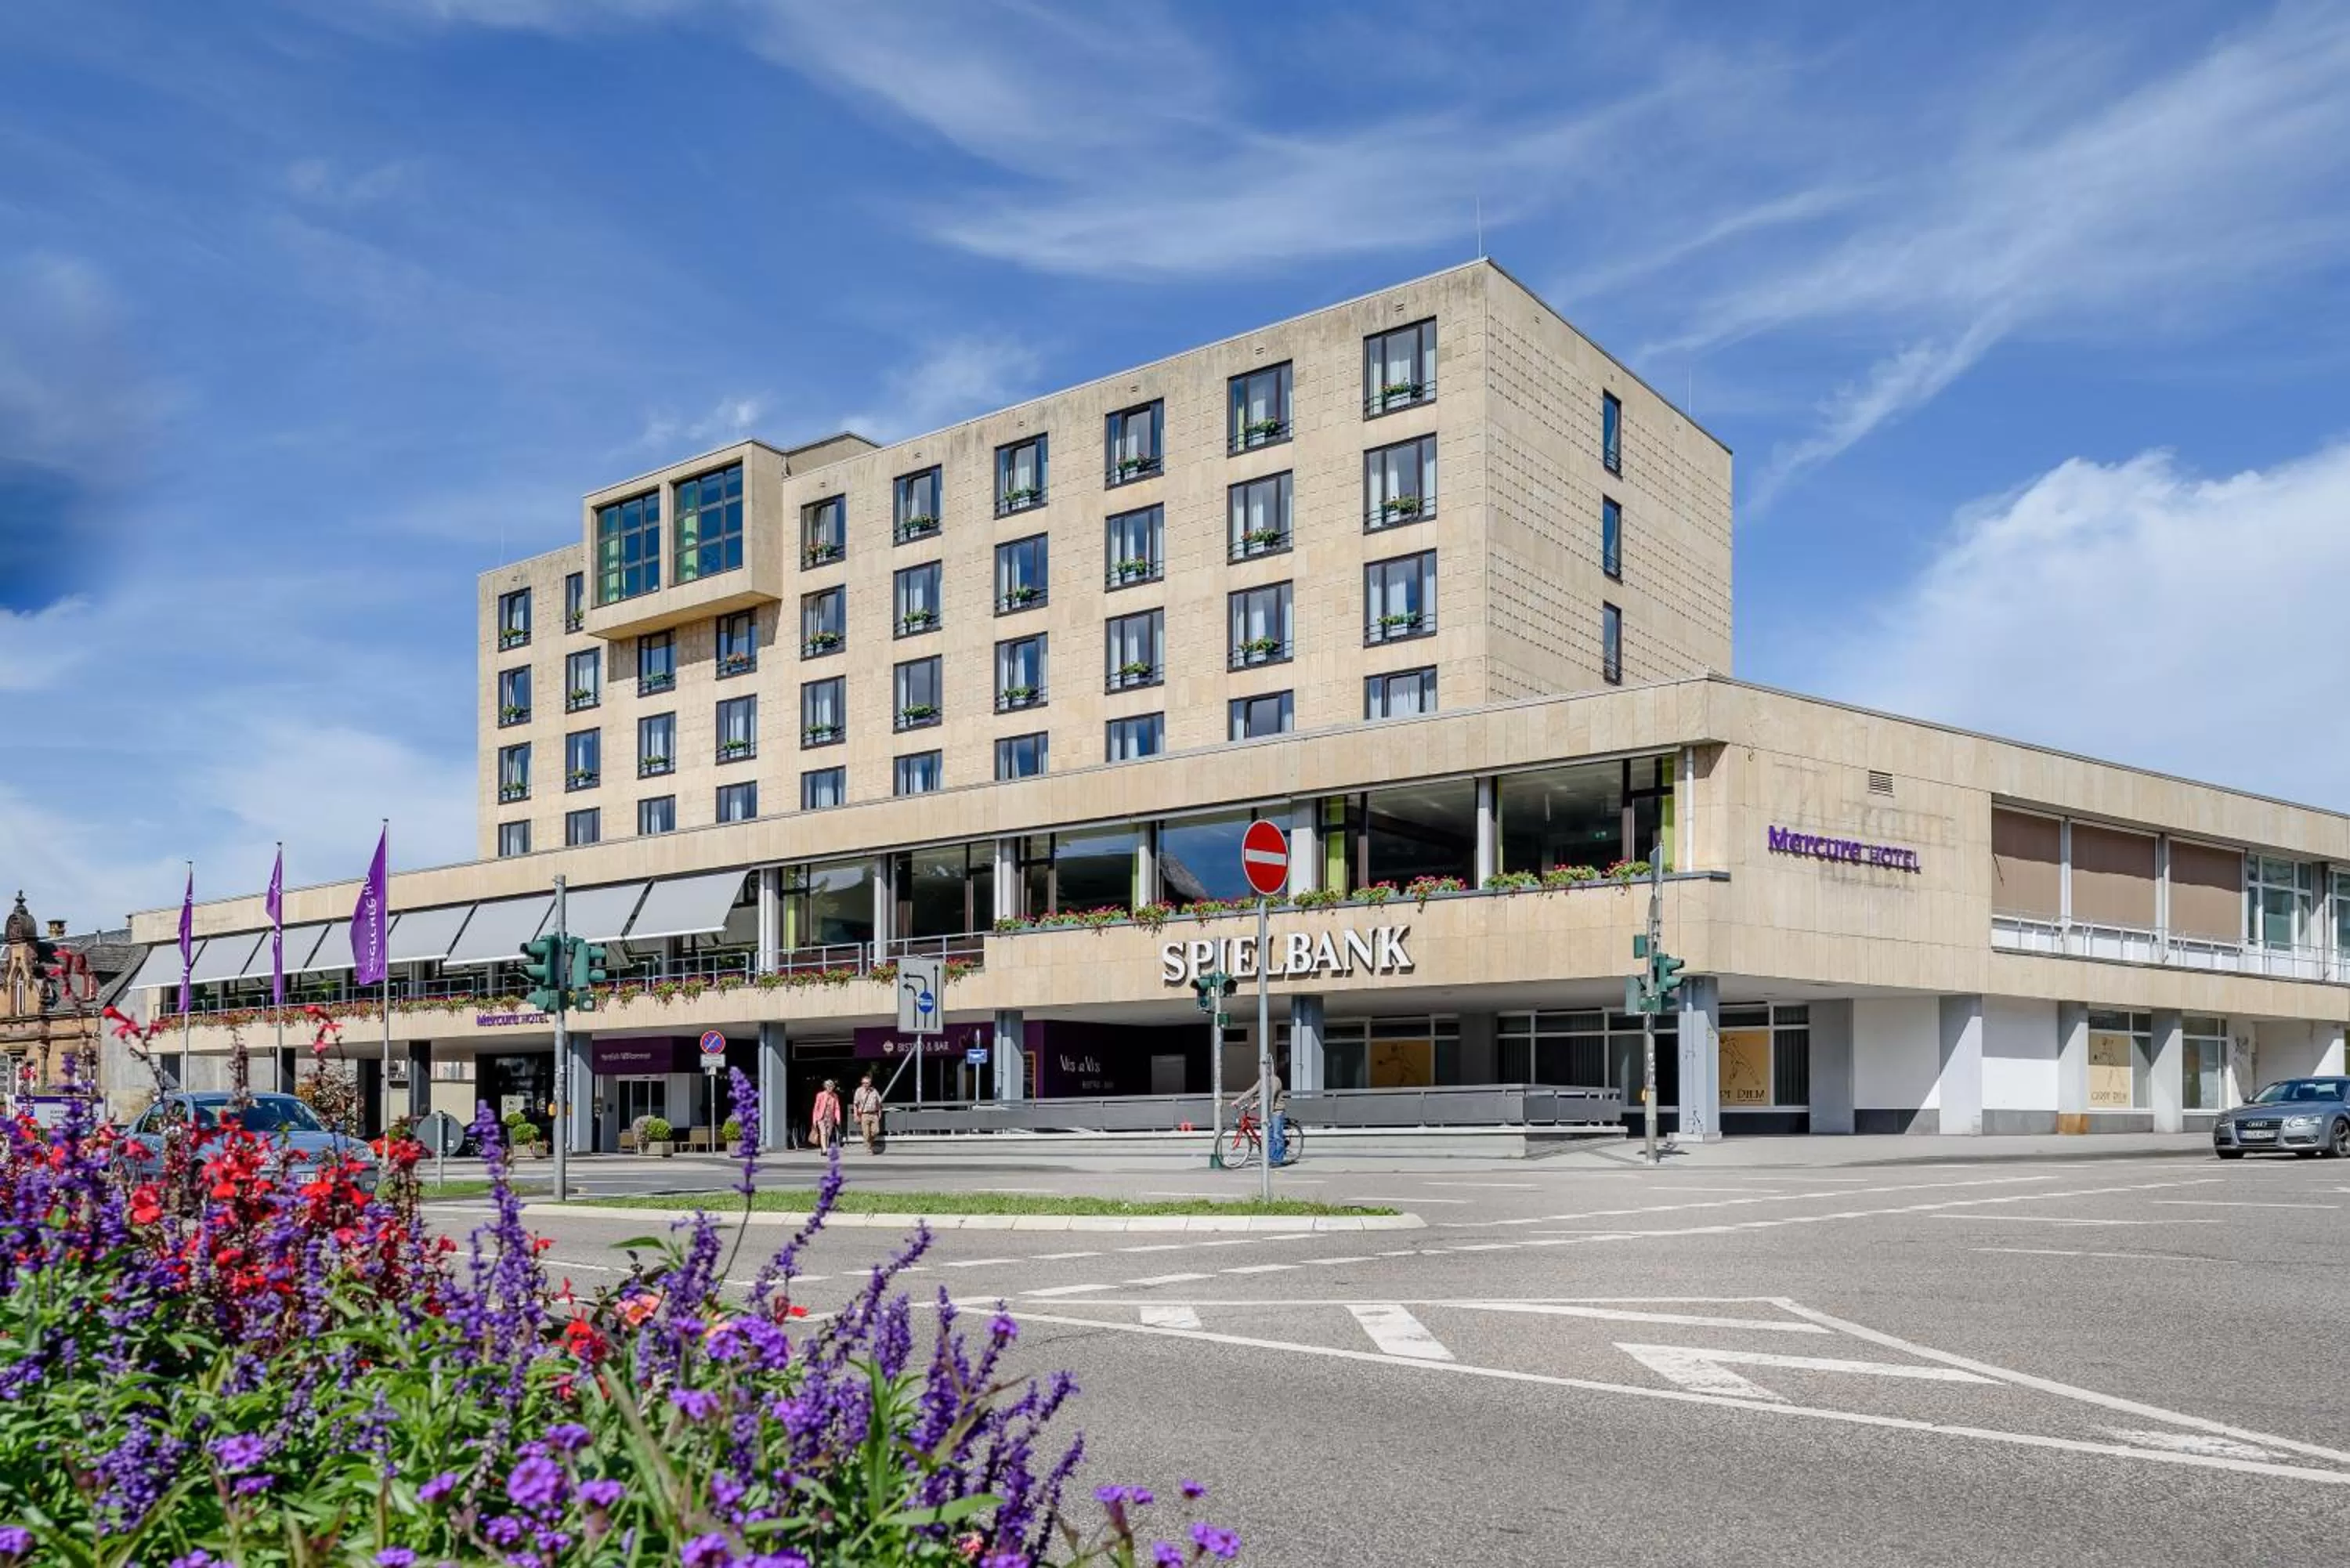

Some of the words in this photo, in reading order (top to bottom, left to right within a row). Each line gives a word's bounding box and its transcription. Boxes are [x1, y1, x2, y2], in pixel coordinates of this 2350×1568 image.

[1768, 826, 1863, 864] Mercure
[1868, 844, 1921, 873] HOTEL
[1162, 925, 1413, 985] SPIELBANK
[475, 1014, 519, 1026] Mercure
